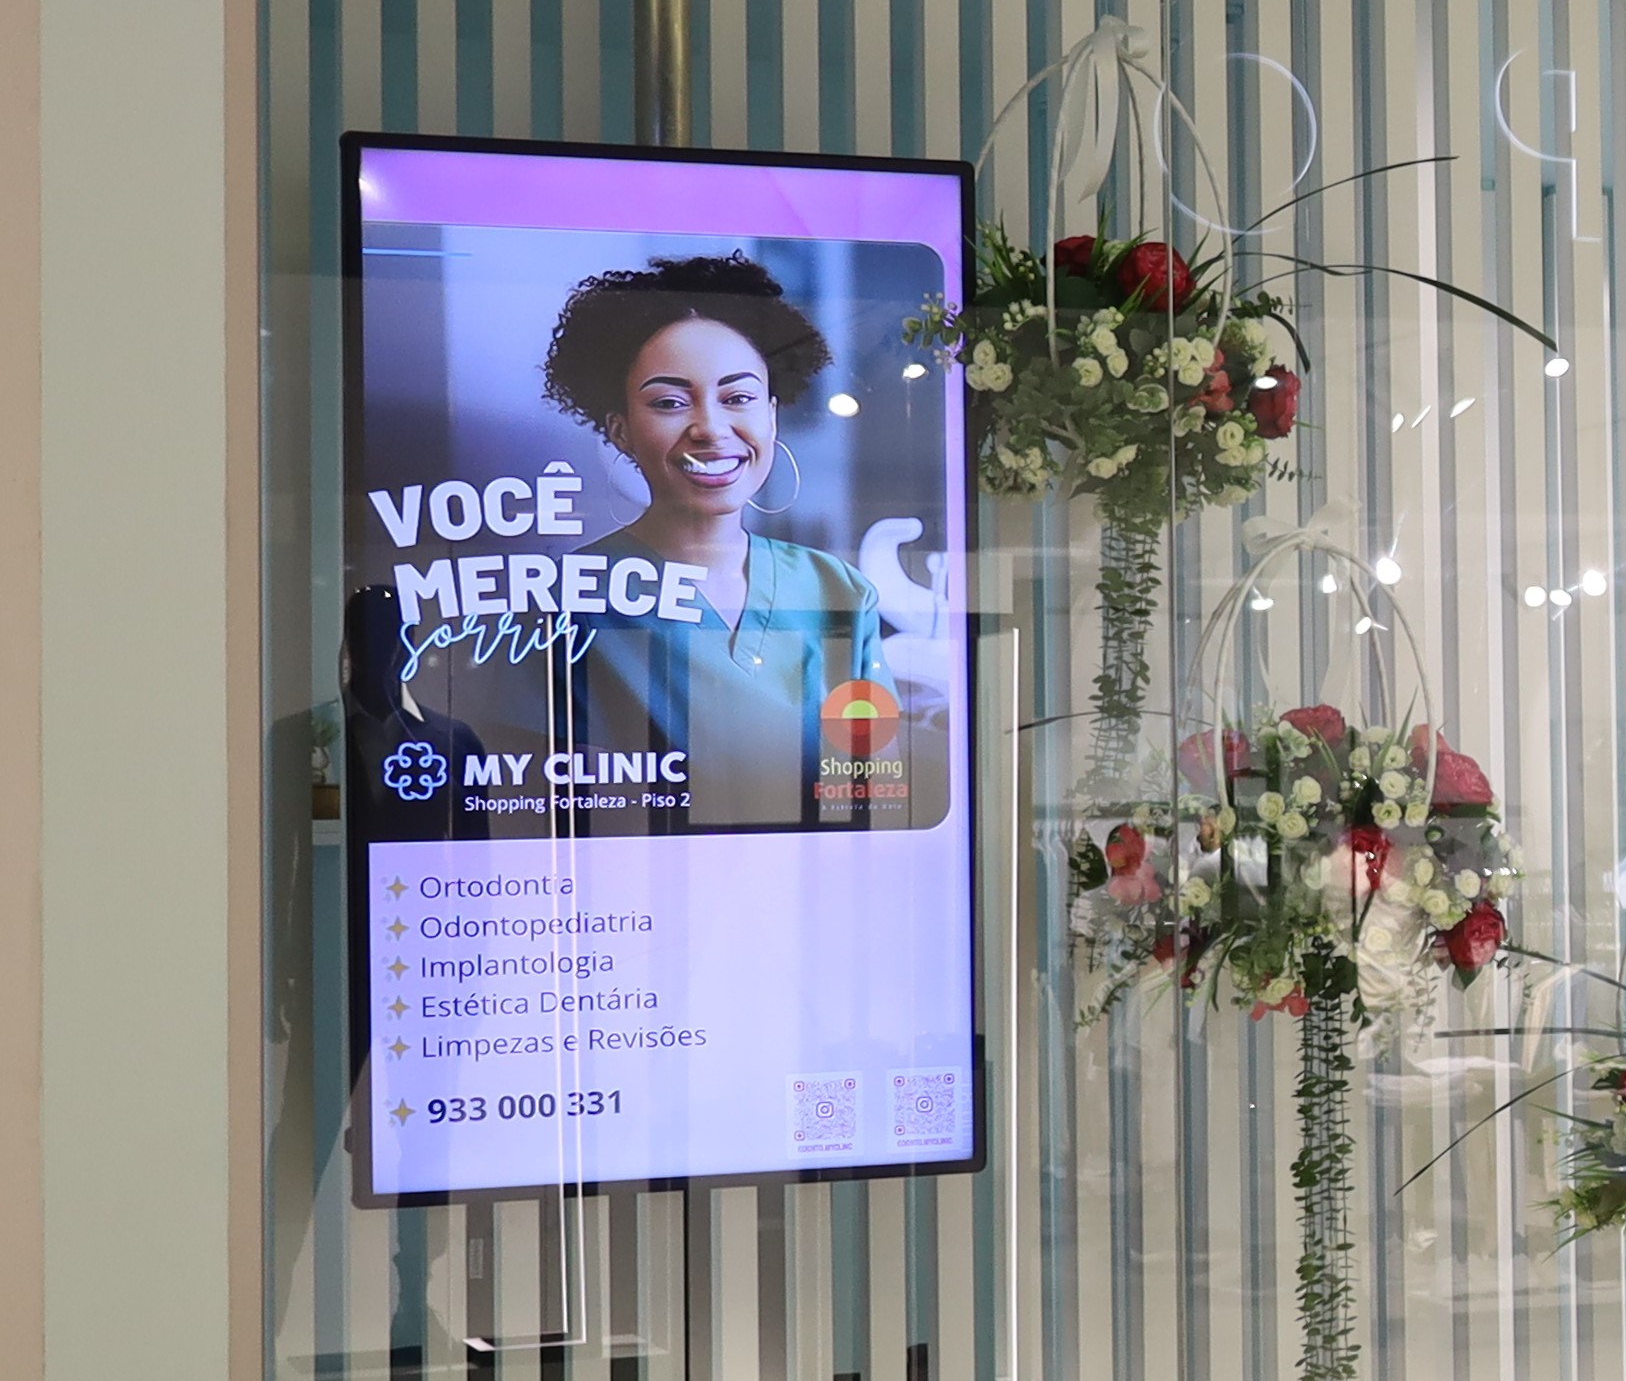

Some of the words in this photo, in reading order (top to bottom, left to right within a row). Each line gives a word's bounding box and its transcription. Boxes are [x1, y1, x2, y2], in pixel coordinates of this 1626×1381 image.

[368, 461, 583, 547] VOCÊ
[394, 554, 708, 624] MERECE
[400, 610, 597, 682] sorrir
[464, 753, 533, 786] MY
[544, 751, 687, 785] CLINIC
[820, 757, 903, 779] Shopping
[464, 795, 546, 813] Shopping
[550, 793, 626, 809] Fortaleza
[642, 793, 675, 808] Piso
[680, 793, 691, 808] 2
[813, 781, 909, 799] Fortaleza
[420, 874, 574, 899] Ortodonta
[420, 911, 653, 941] Odontopediatria
[421, 951, 614, 982] Implantologia
[422, 992, 529, 1018] Estética
[540, 988, 659, 1013] Dentária
[422, 1033, 554, 1061] Limpezas
[563, 1035, 579, 1051] e
[589, 1025, 707, 1051] Revisões
[427, 1097, 488, 1124] 933
[498, 1093, 556, 1120] 000
[566, 1090, 622, 1116] 331
